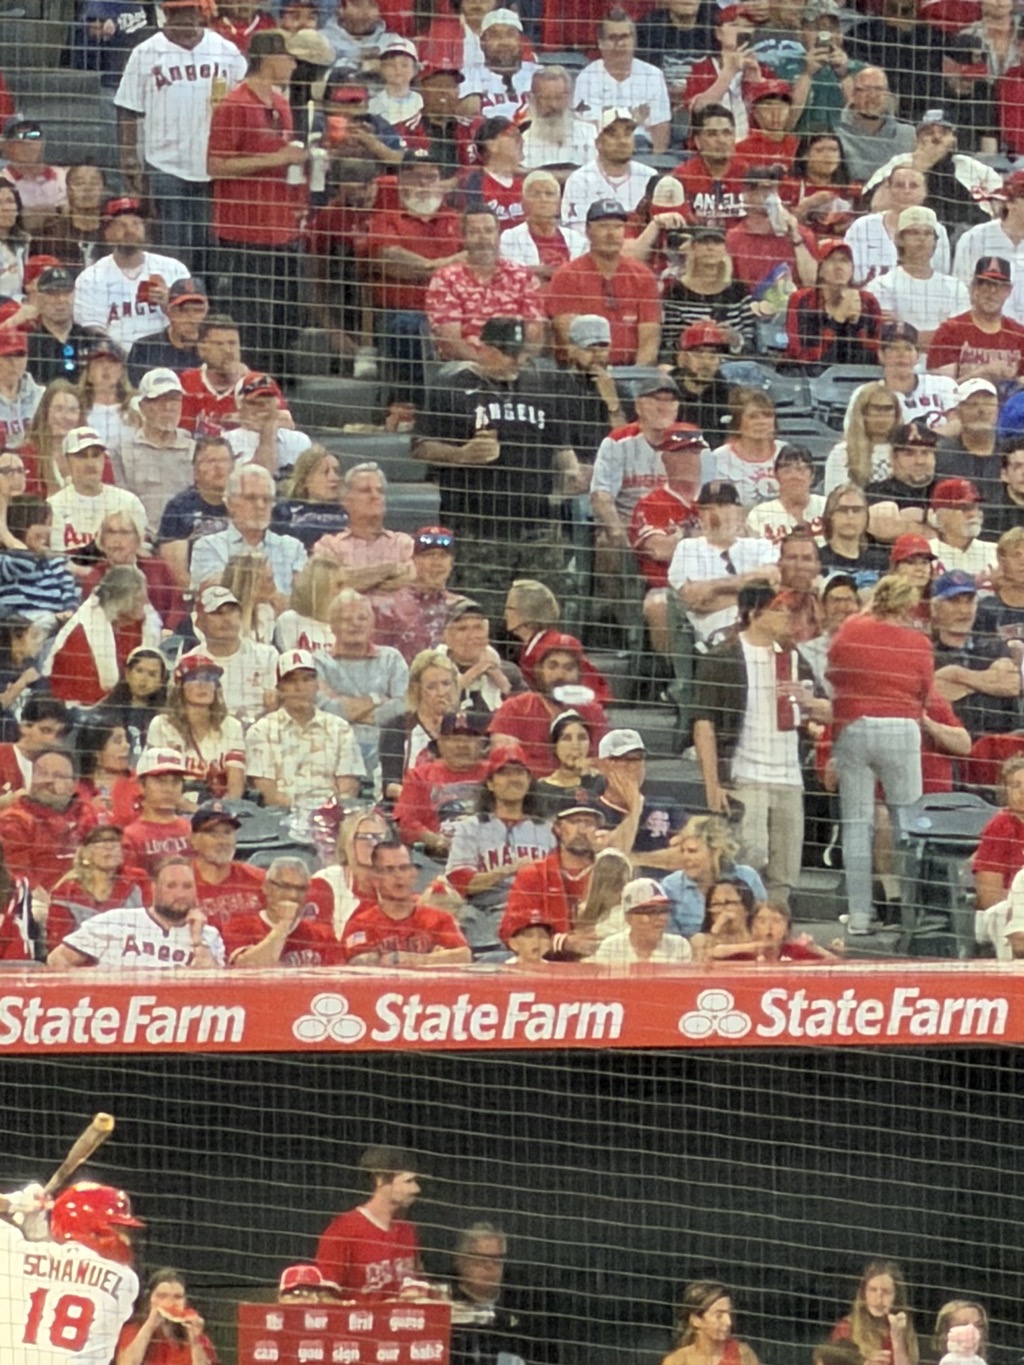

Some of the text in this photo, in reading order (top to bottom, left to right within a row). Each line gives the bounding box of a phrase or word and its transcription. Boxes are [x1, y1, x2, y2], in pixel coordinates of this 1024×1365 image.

[475, 402, 545, 430] ANGELS
[122, 934, 196, 967] Angel
[23, 1253, 124, 1302] SCHANUEL
[21, 1287, 96, 1352] 18
